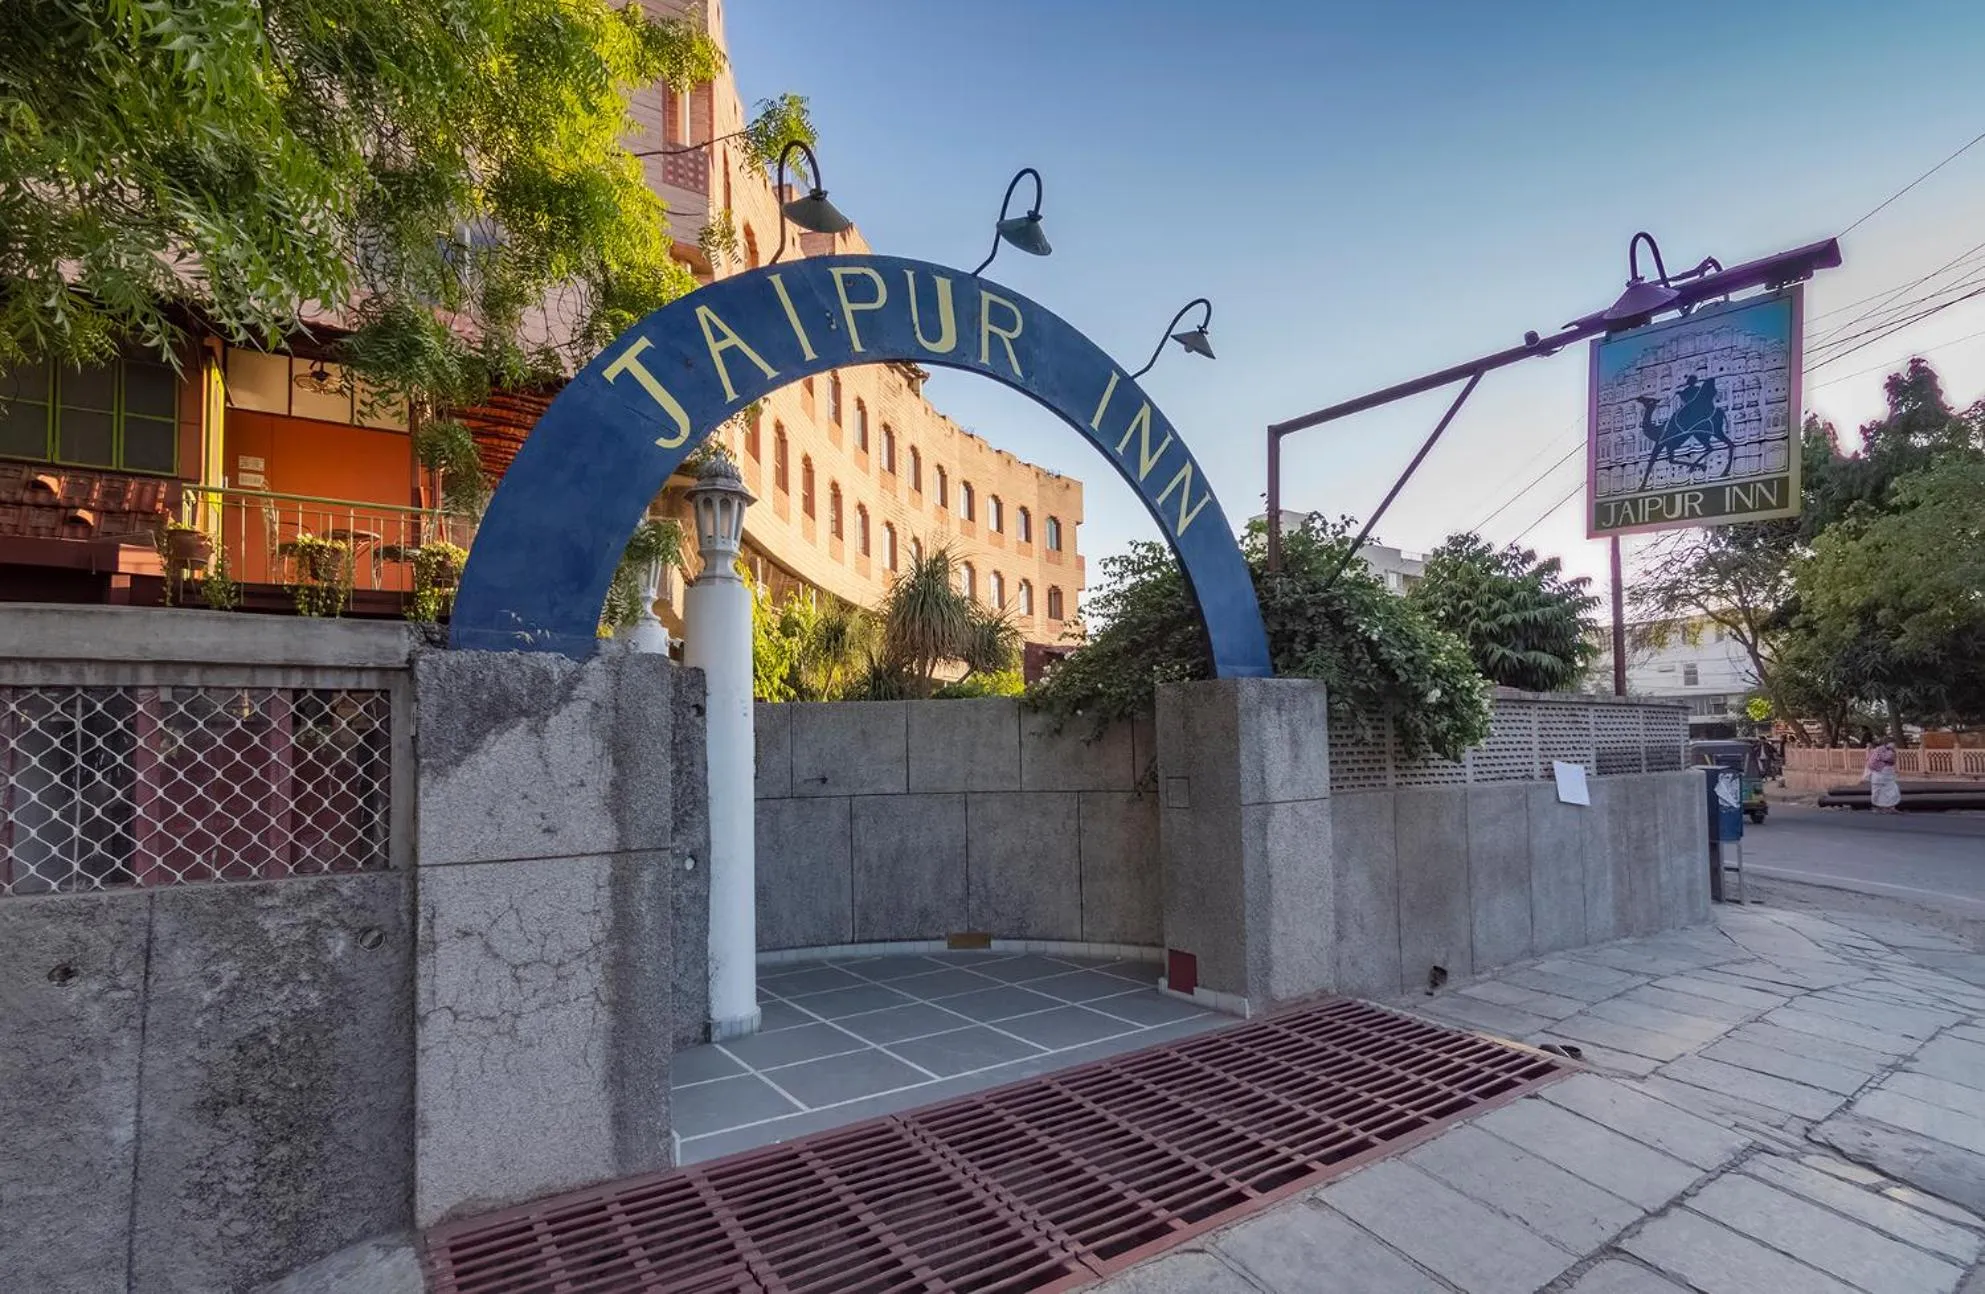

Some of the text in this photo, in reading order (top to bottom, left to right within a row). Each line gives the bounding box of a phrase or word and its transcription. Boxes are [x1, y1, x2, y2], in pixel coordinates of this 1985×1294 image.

[603, 267, 1212, 537] JAIPUR INN
[1602, 480, 1777, 527] JAIPUR INN
